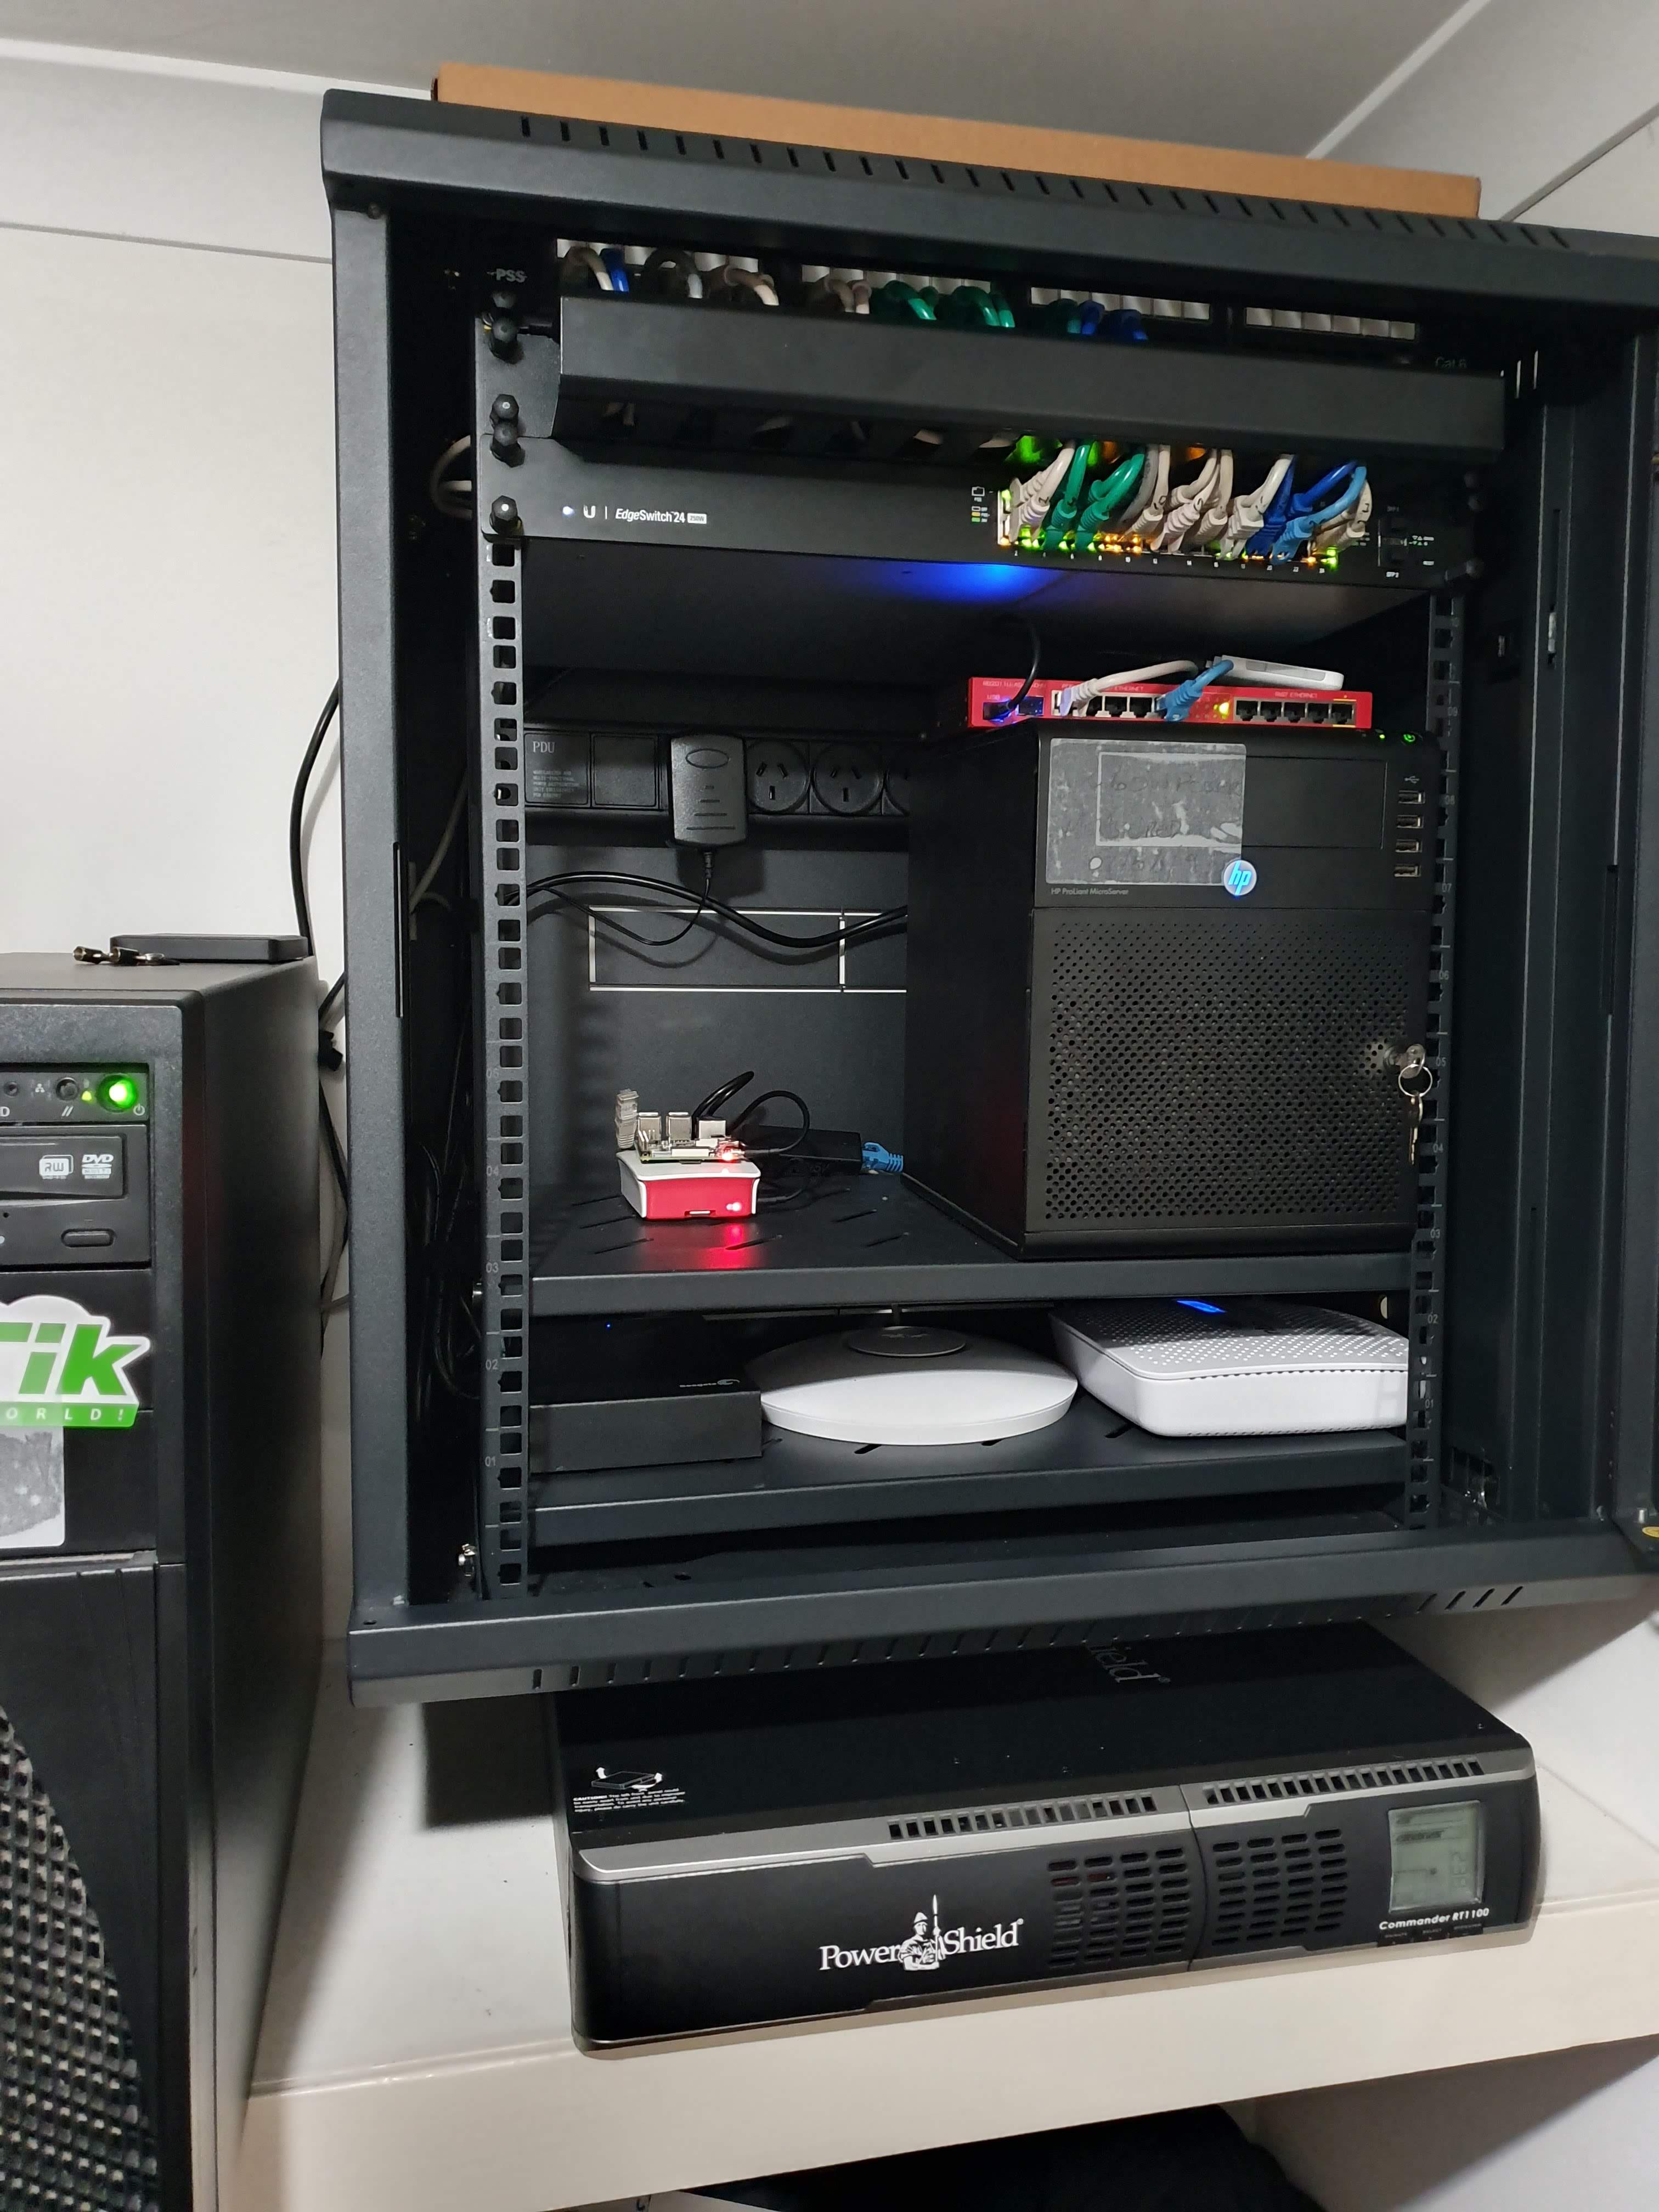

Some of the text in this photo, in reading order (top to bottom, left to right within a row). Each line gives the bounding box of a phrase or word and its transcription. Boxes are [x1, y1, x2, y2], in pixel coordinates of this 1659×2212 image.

[533, 741, 555, 753] PDU
[1228, 861, 1251, 896] hp
[1442, 882, 1451, 892] 07
[1436, 1057, 1446, 1067] 05
[1432, 1143, 1443, 1153] 04
[82, 1154, 114, 1164] DVD
[486, 1165, 499, 1176] 04
[1430, 1228, 1439, 1238] 03
[486, 1262, 498, 1273] 03
[1427, 1314, 1437, 1324] 02
[486, 1359, 498, 1370] 02
[1425, 1399, 1433, 1409] 01
[484, 1456, 496, 1467] 01
[1378, 1915, 1451, 1930] Commander
[1452, 1908, 1490, 1921] RT1100
